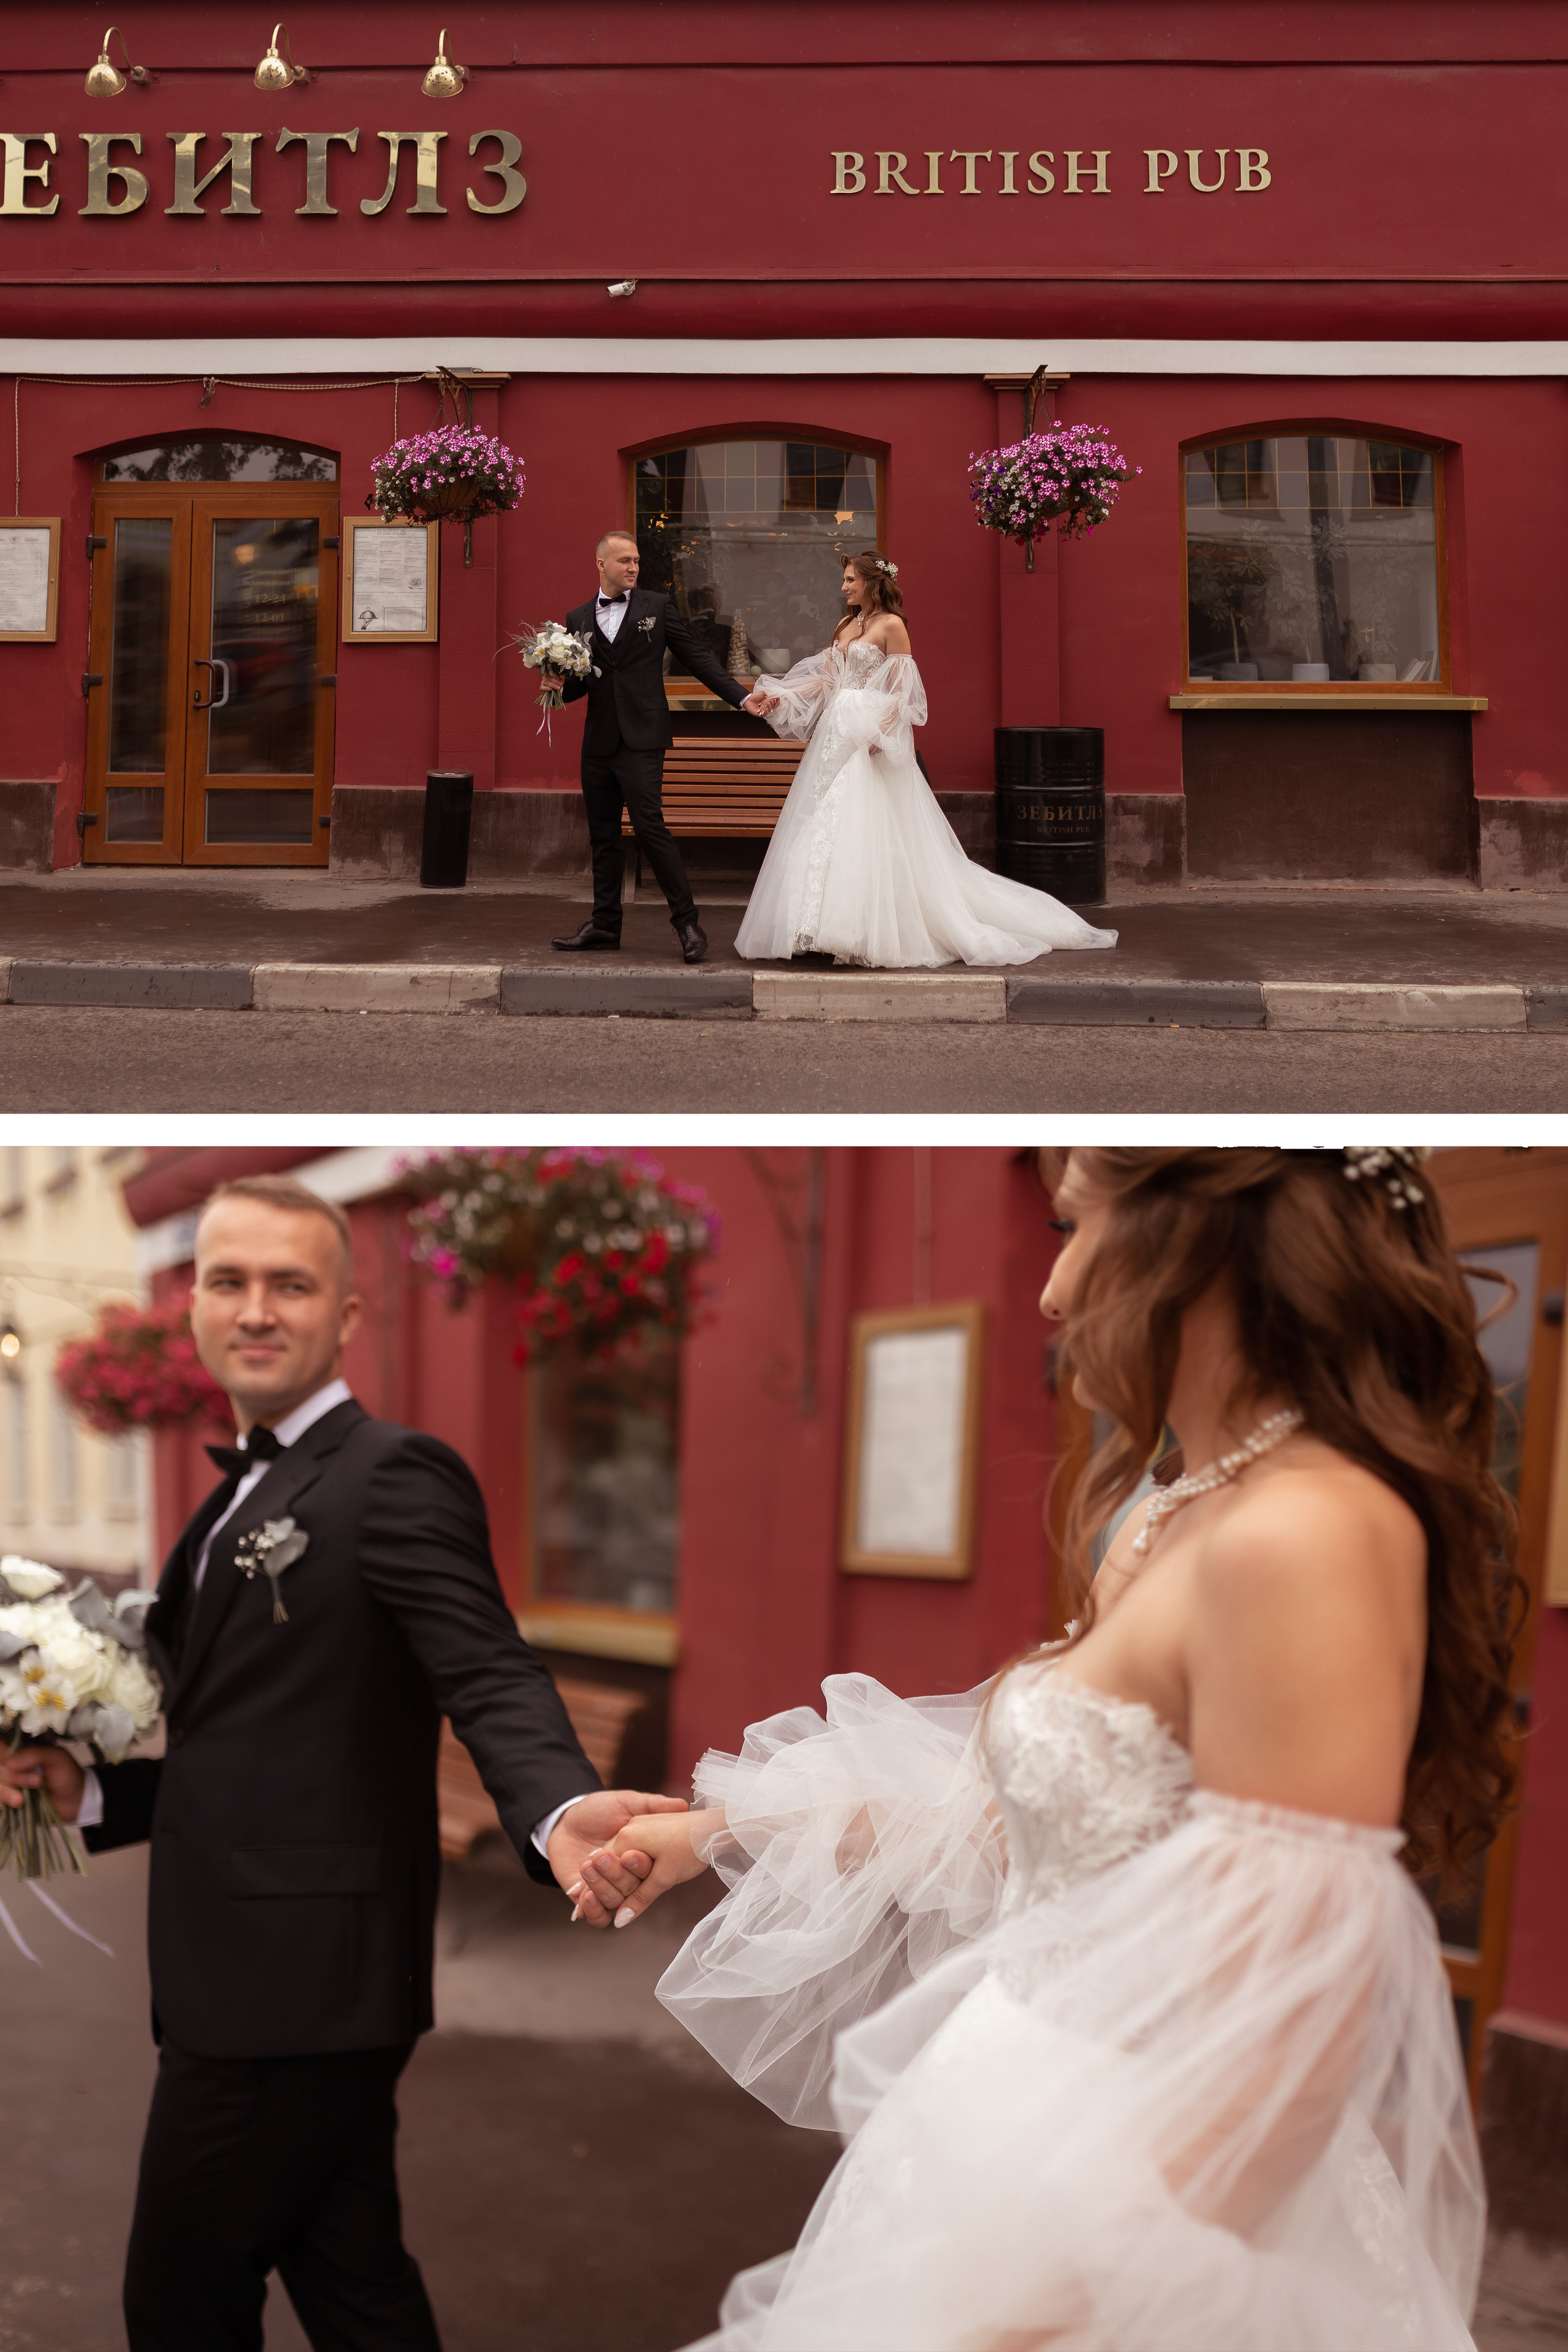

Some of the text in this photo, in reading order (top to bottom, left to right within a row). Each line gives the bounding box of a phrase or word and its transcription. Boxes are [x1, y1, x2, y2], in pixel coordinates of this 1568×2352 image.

[0, 127, 527, 216] ЕБИТЛЗ
[829, 148, 1273, 195] BRITISH PUB
[254, 594, 285, 604] 12-24
[254, 613, 285, 622] 12-01
[1017, 805, 1102, 821] ЗЕБИТЛЗ
